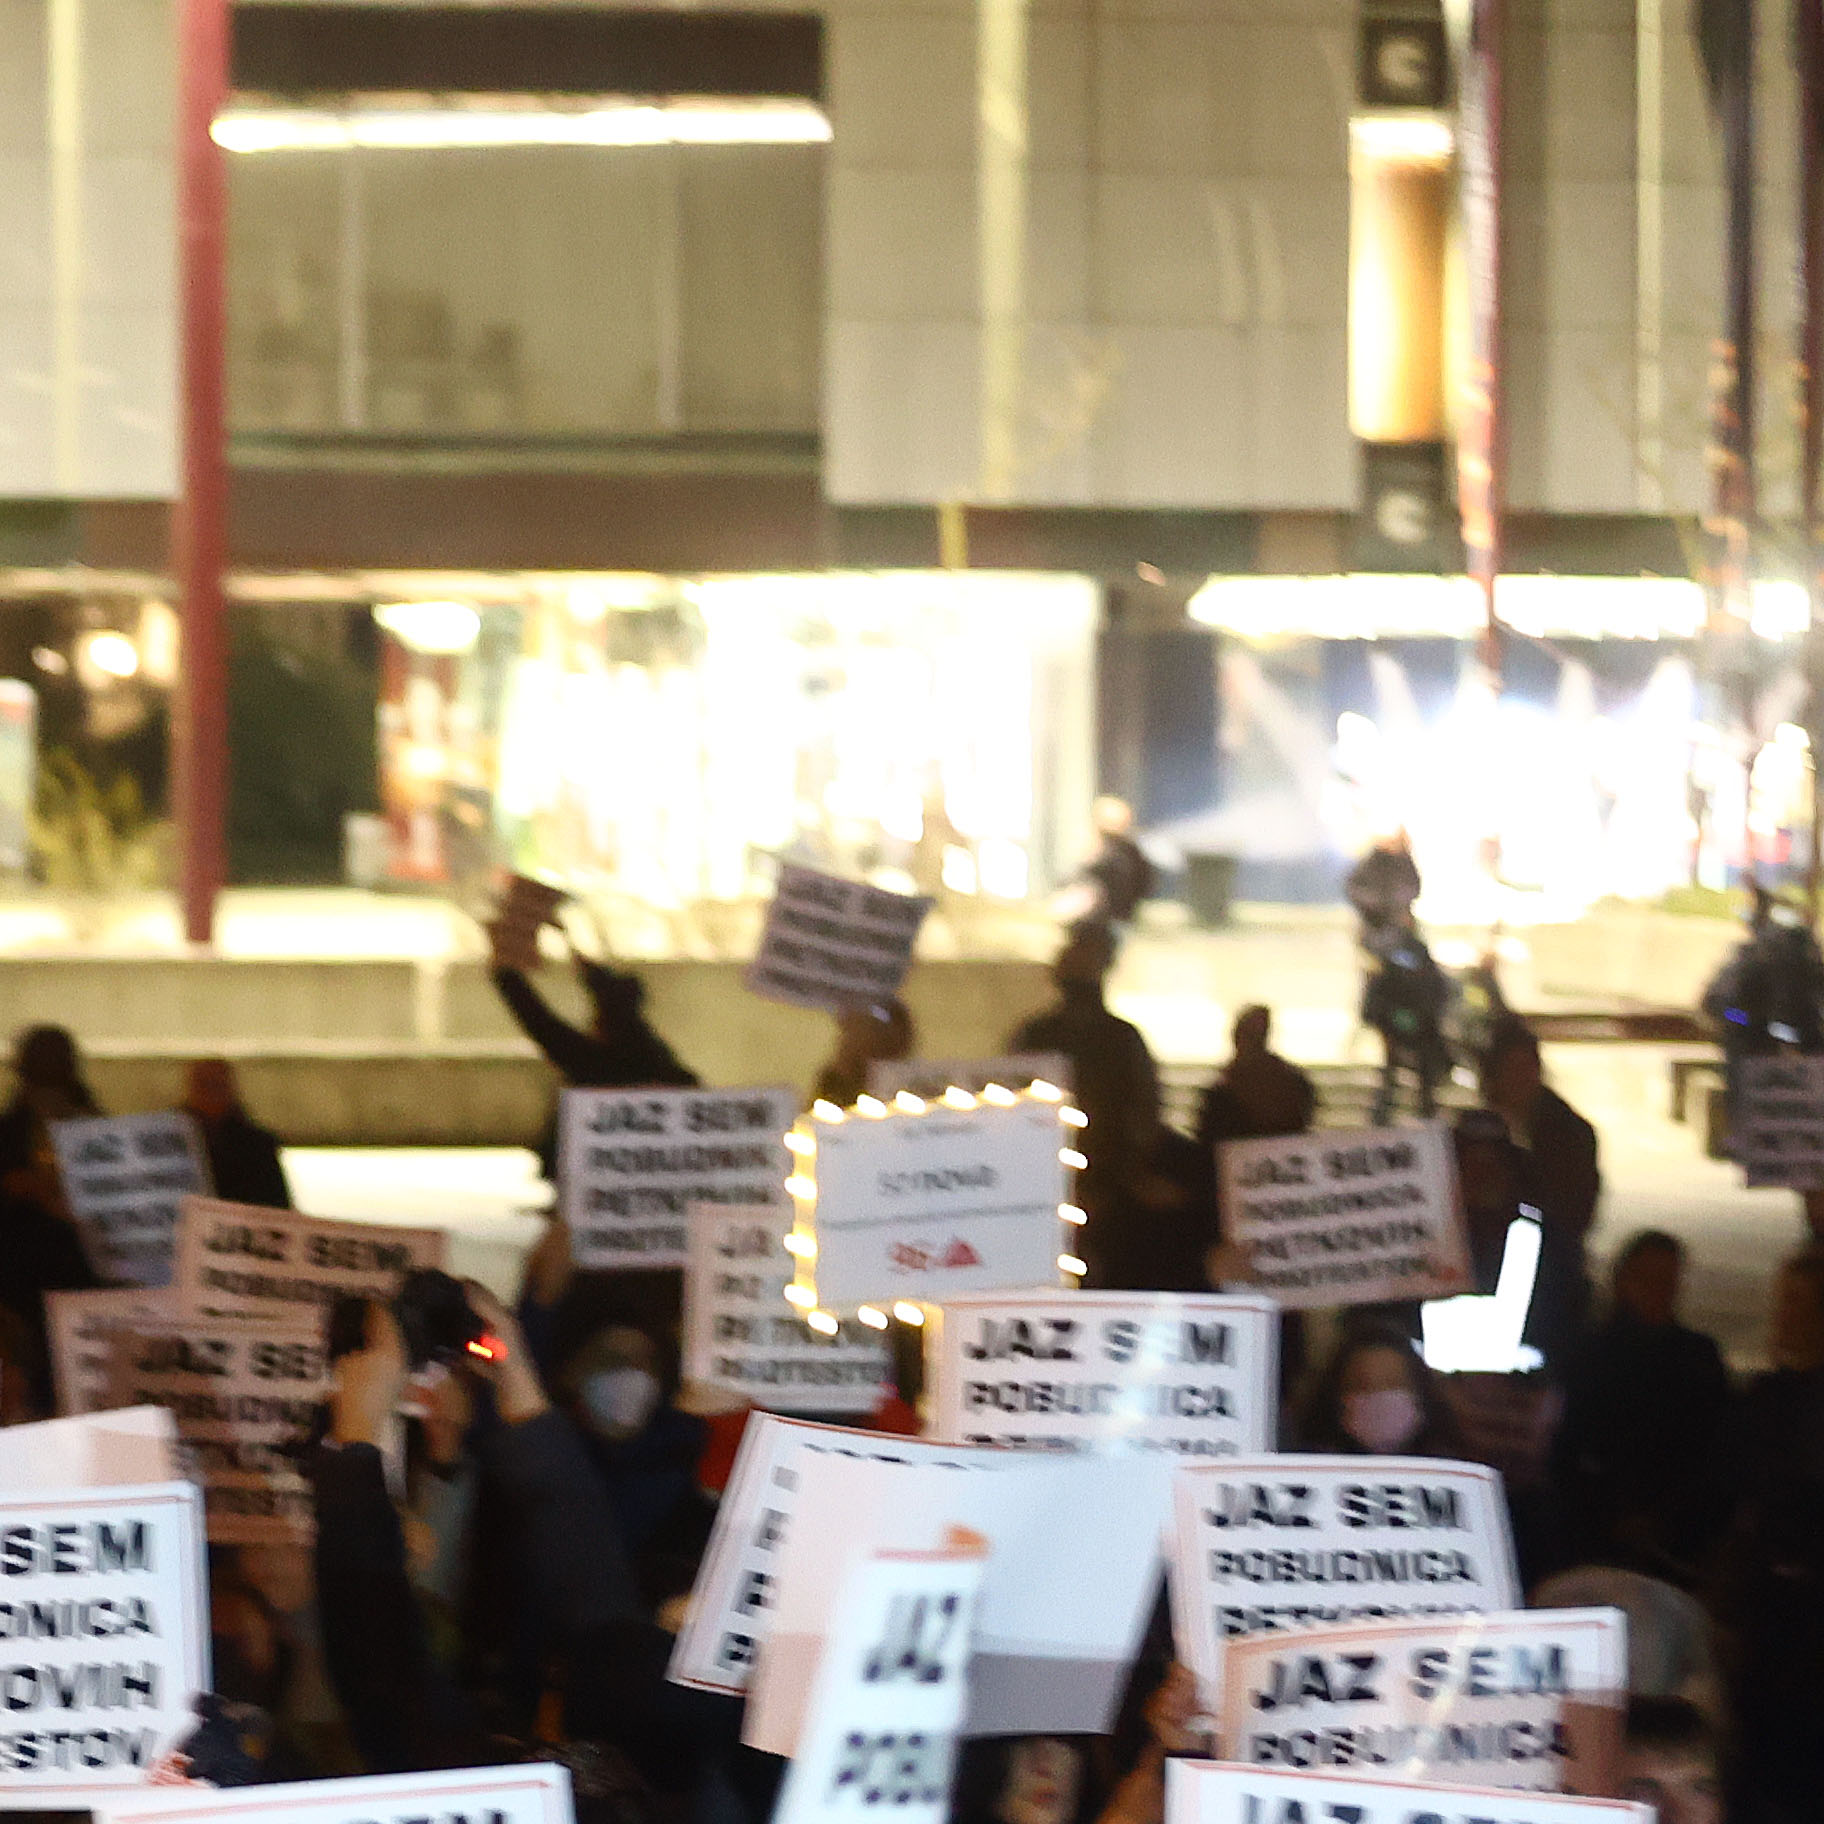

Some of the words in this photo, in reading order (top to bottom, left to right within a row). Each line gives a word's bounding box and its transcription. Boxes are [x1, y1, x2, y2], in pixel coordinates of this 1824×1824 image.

[963, 1316, 1083, 1364] JAZ
[1205, 1482, 1319, 1529] JAZ
[1338, 1482, 1471, 1531] SEM
[1210, 1548, 1482, 1586] POBUDNICA
[1248, 1648, 1384, 1711] JAZ
[1409, 1640, 1570, 1699] SEM
